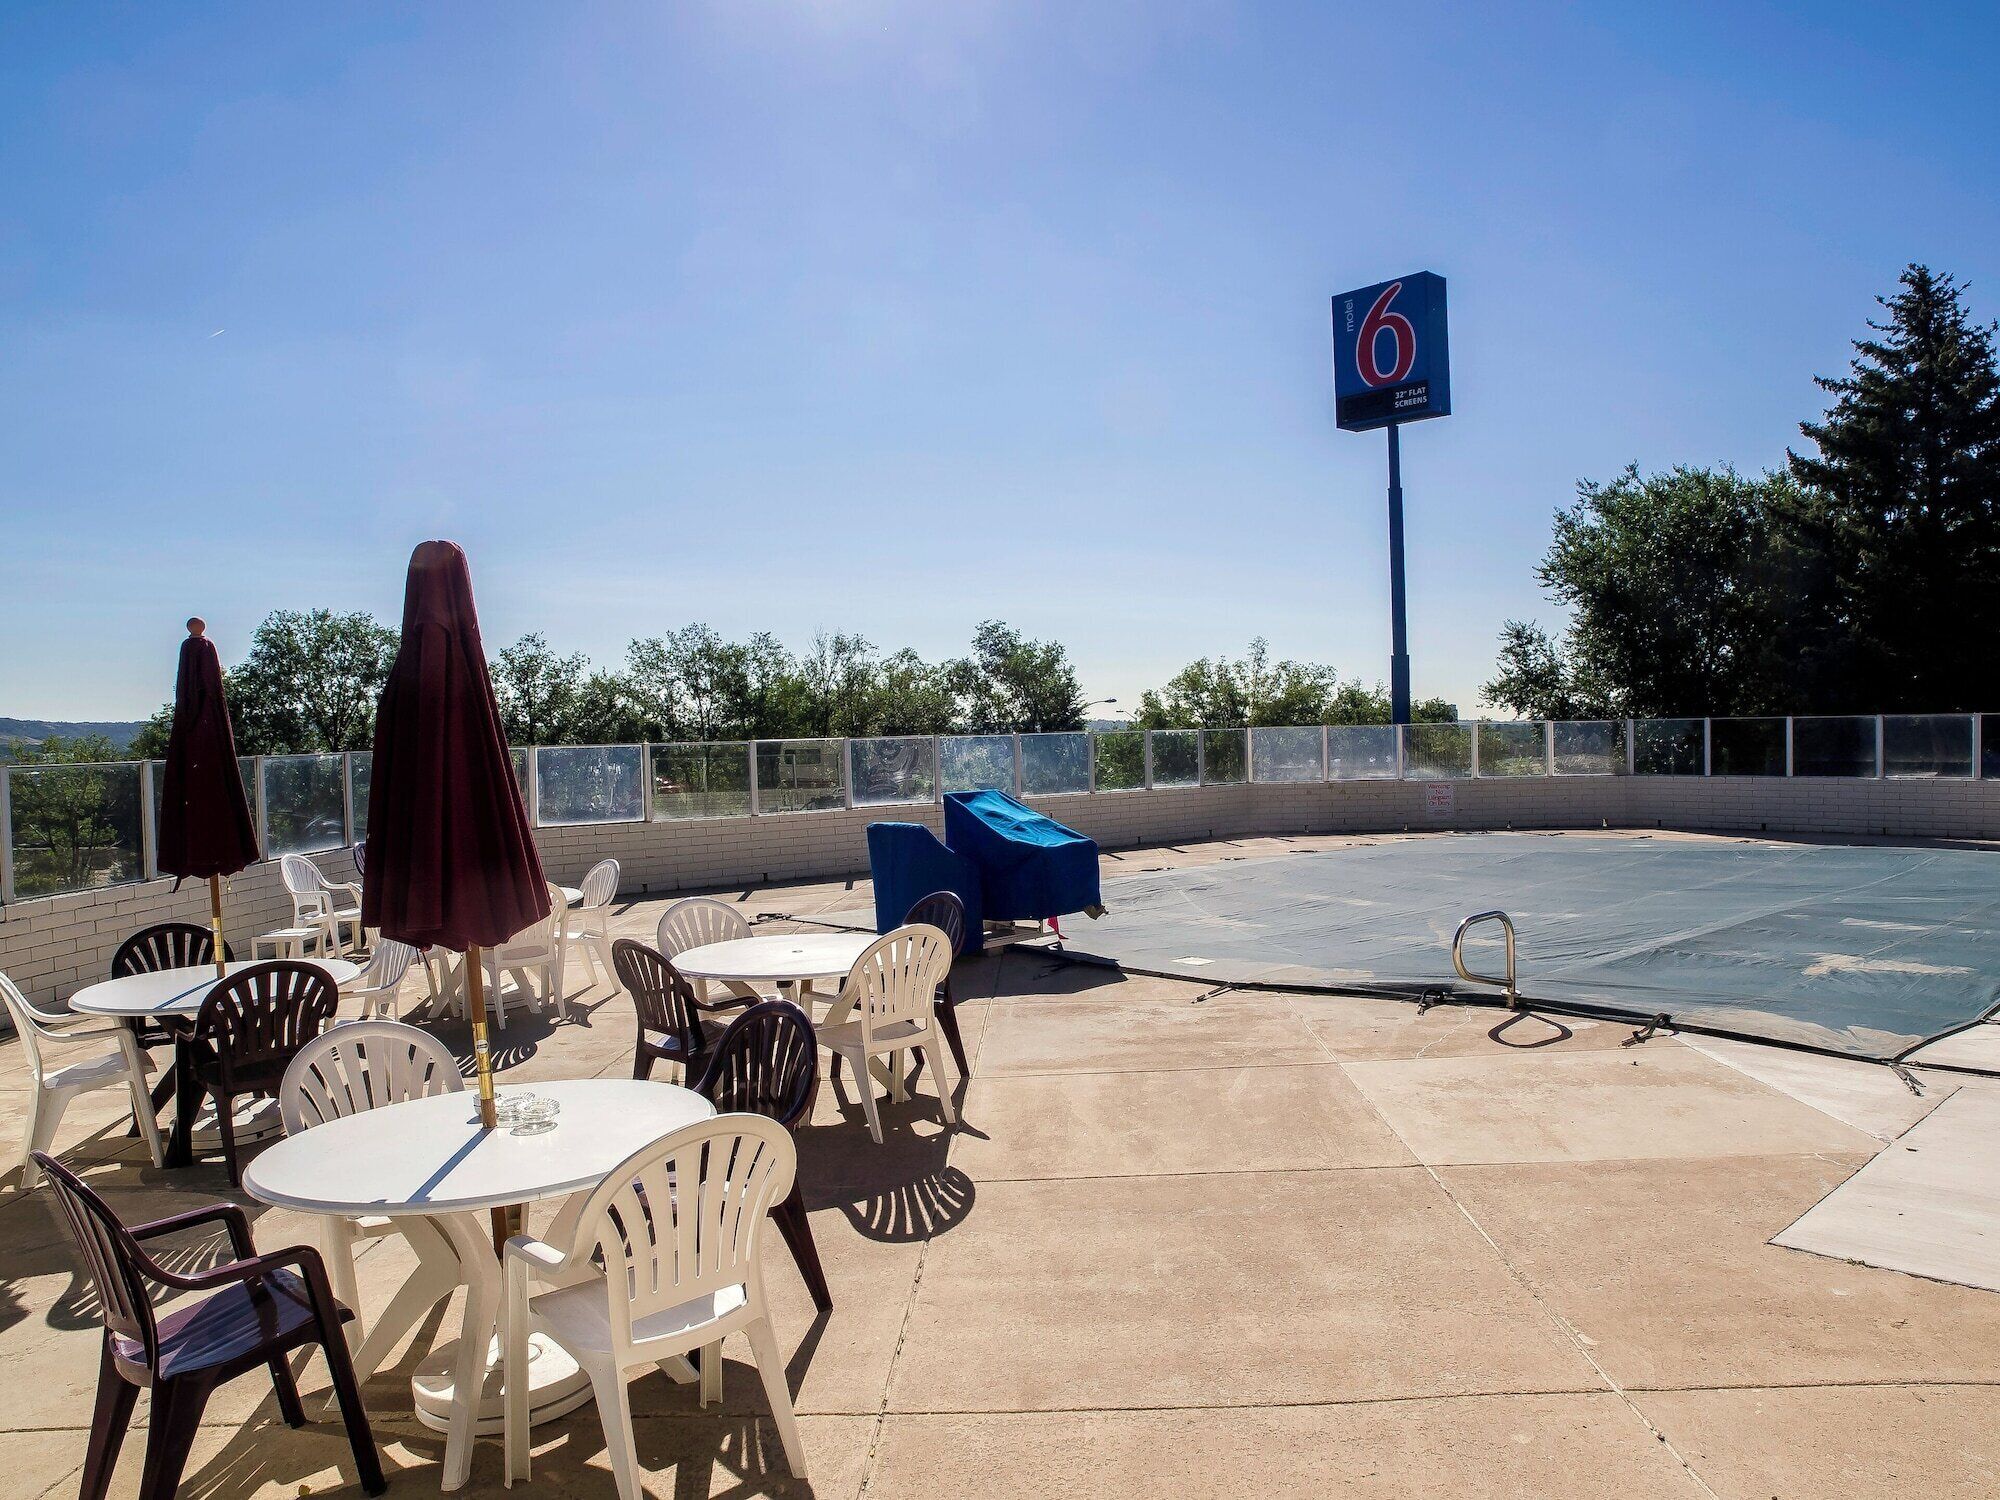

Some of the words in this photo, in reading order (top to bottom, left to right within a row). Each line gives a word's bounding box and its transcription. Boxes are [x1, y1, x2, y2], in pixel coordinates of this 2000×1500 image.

[1344, 299, 1354, 332] motel
[1356, 281, 1416, 388] 6
[1394, 395, 1428, 408] SCREENS
[1408, 386, 1426, 396] FLAT
